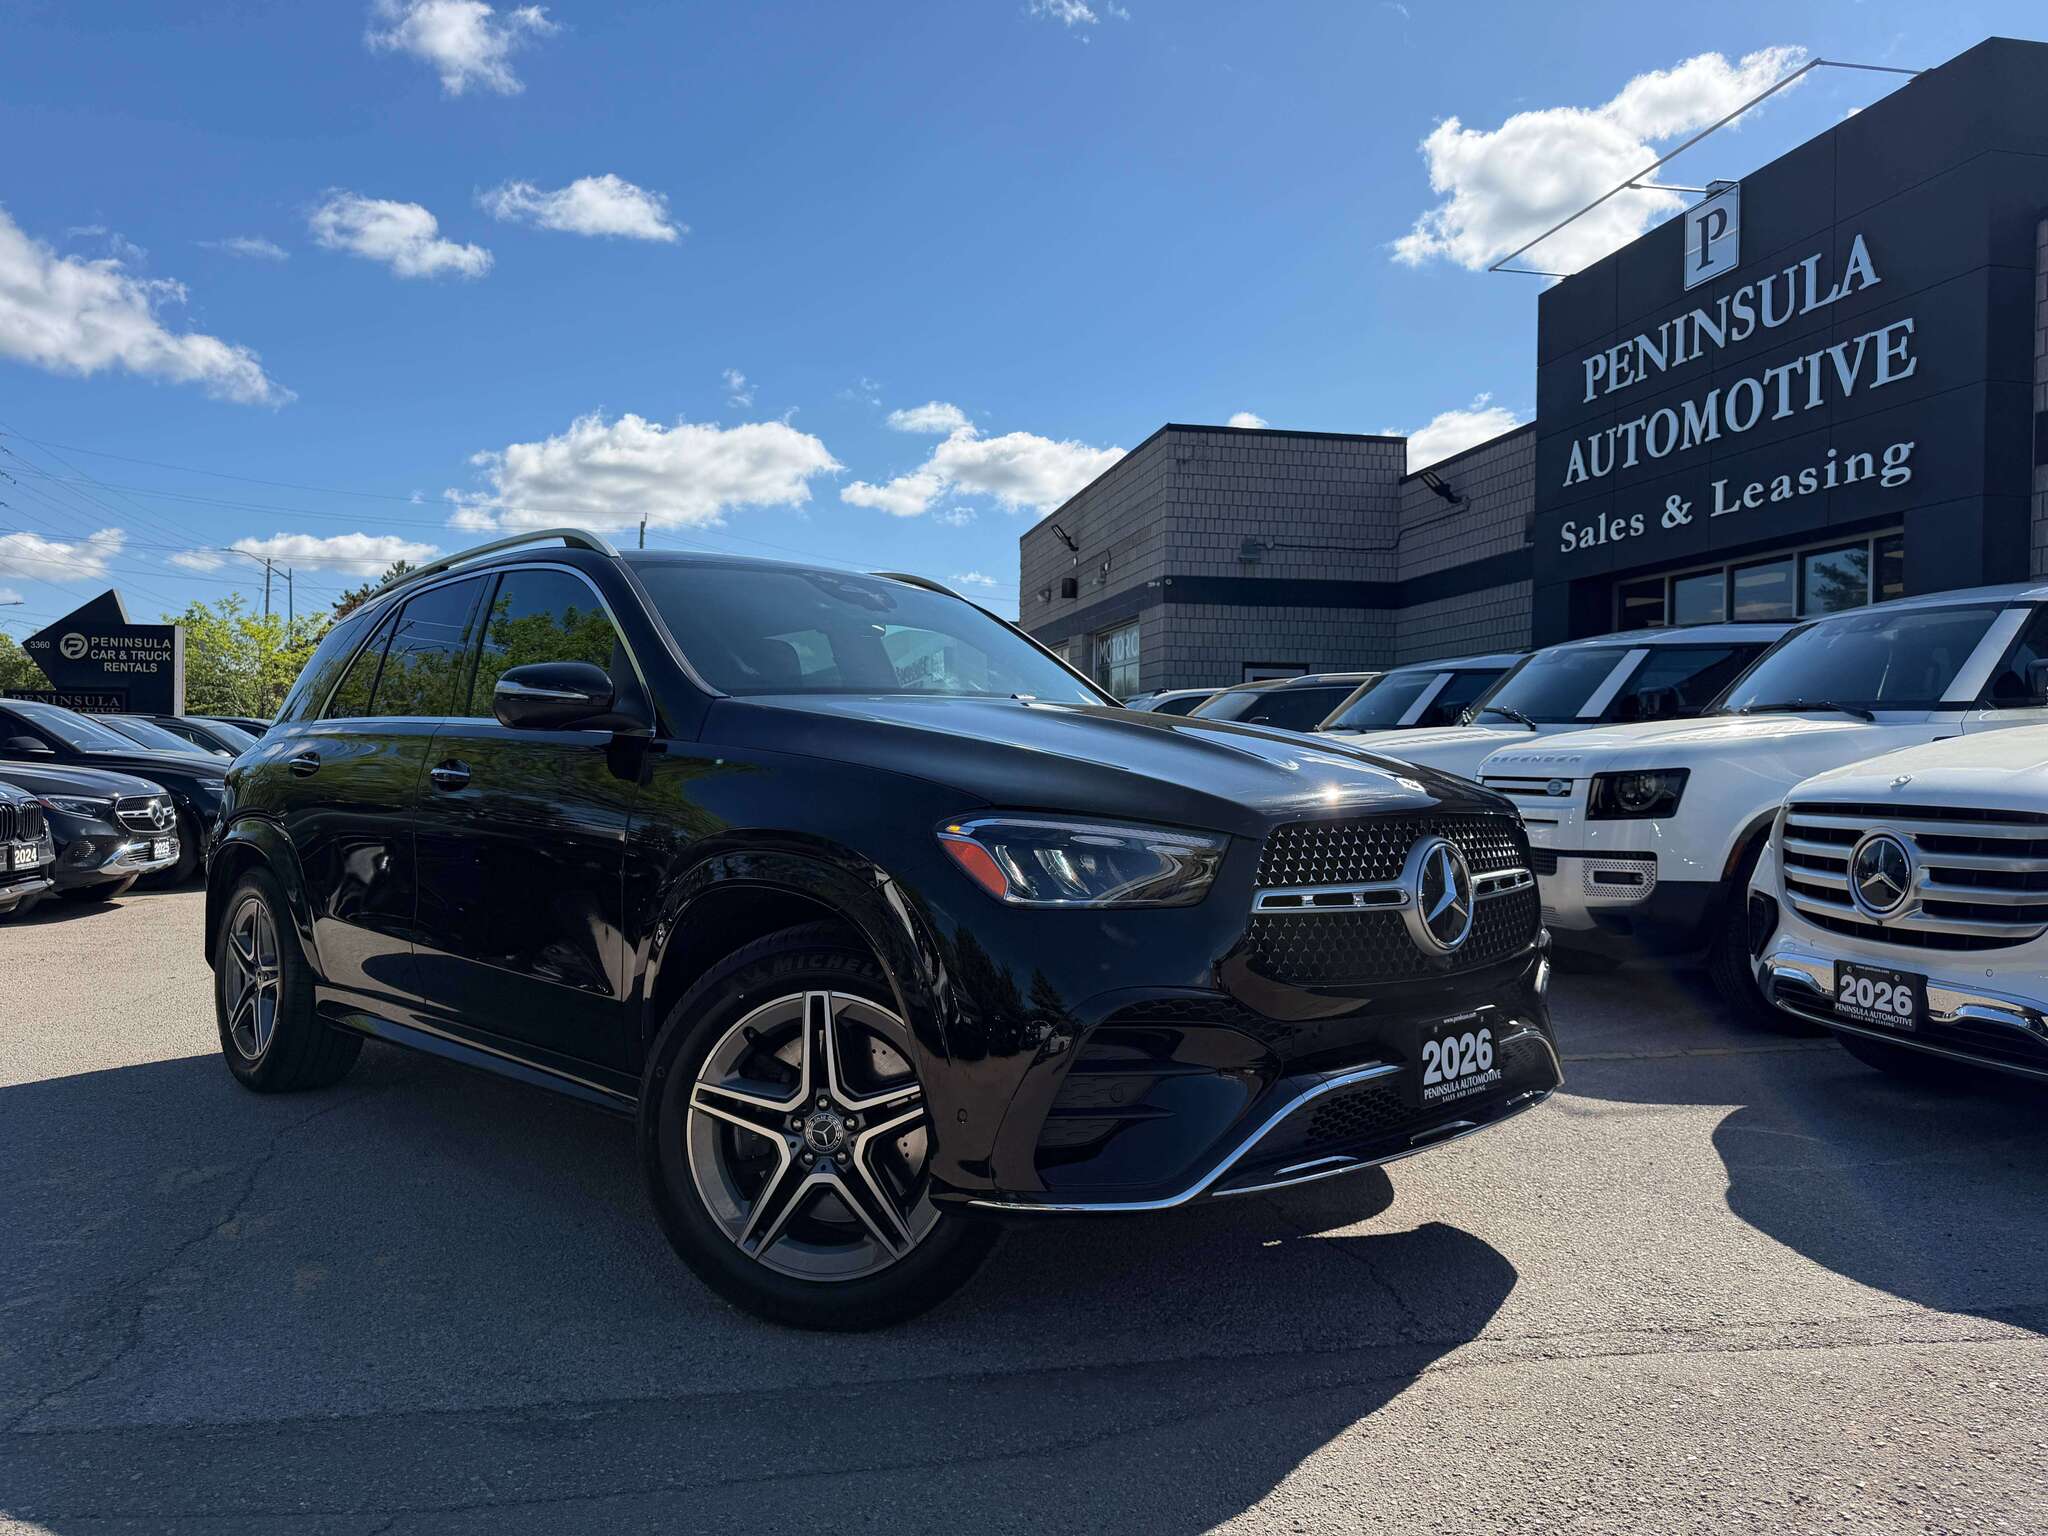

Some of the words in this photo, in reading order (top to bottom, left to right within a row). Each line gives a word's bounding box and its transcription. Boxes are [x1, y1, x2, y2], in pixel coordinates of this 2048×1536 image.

[1695, 206, 1728, 272] P
[1582, 233, 1882, 404] PENINSULA
[1562, 317, 1919, 487] AUTOMOTIVE
[1560, 512, 1645, 553] Sales
[1660, 494, 1694, 529] &
[1709, 441, 1915, 518] Leasing
[30, 640, 50, 649] 3360
[90, 637, 172, 649] PENINSULA
[90, 650, 116, 660] CAR
[118, 650, 128, 660] &
[131, 650, 171, 661] TRUCK
[103, 662, 158, 673] RENTALS
[1491, 755, 1583, 763] DEFENDER
[15, 847, 38, 864] 2024
[1840, 974, 1913, 1017] 2026
[1834, 1002, 1869, 1017] PENINSULA
[1869, 1010, 1913, 1027] AUTOMOTIVE
[1422, 1027, 1493, 1086] 2026
[1423, 1080, 1460, 1100] PENINSULA
[1460, 1069, 1502, 1090] AUTOMOTIVE
